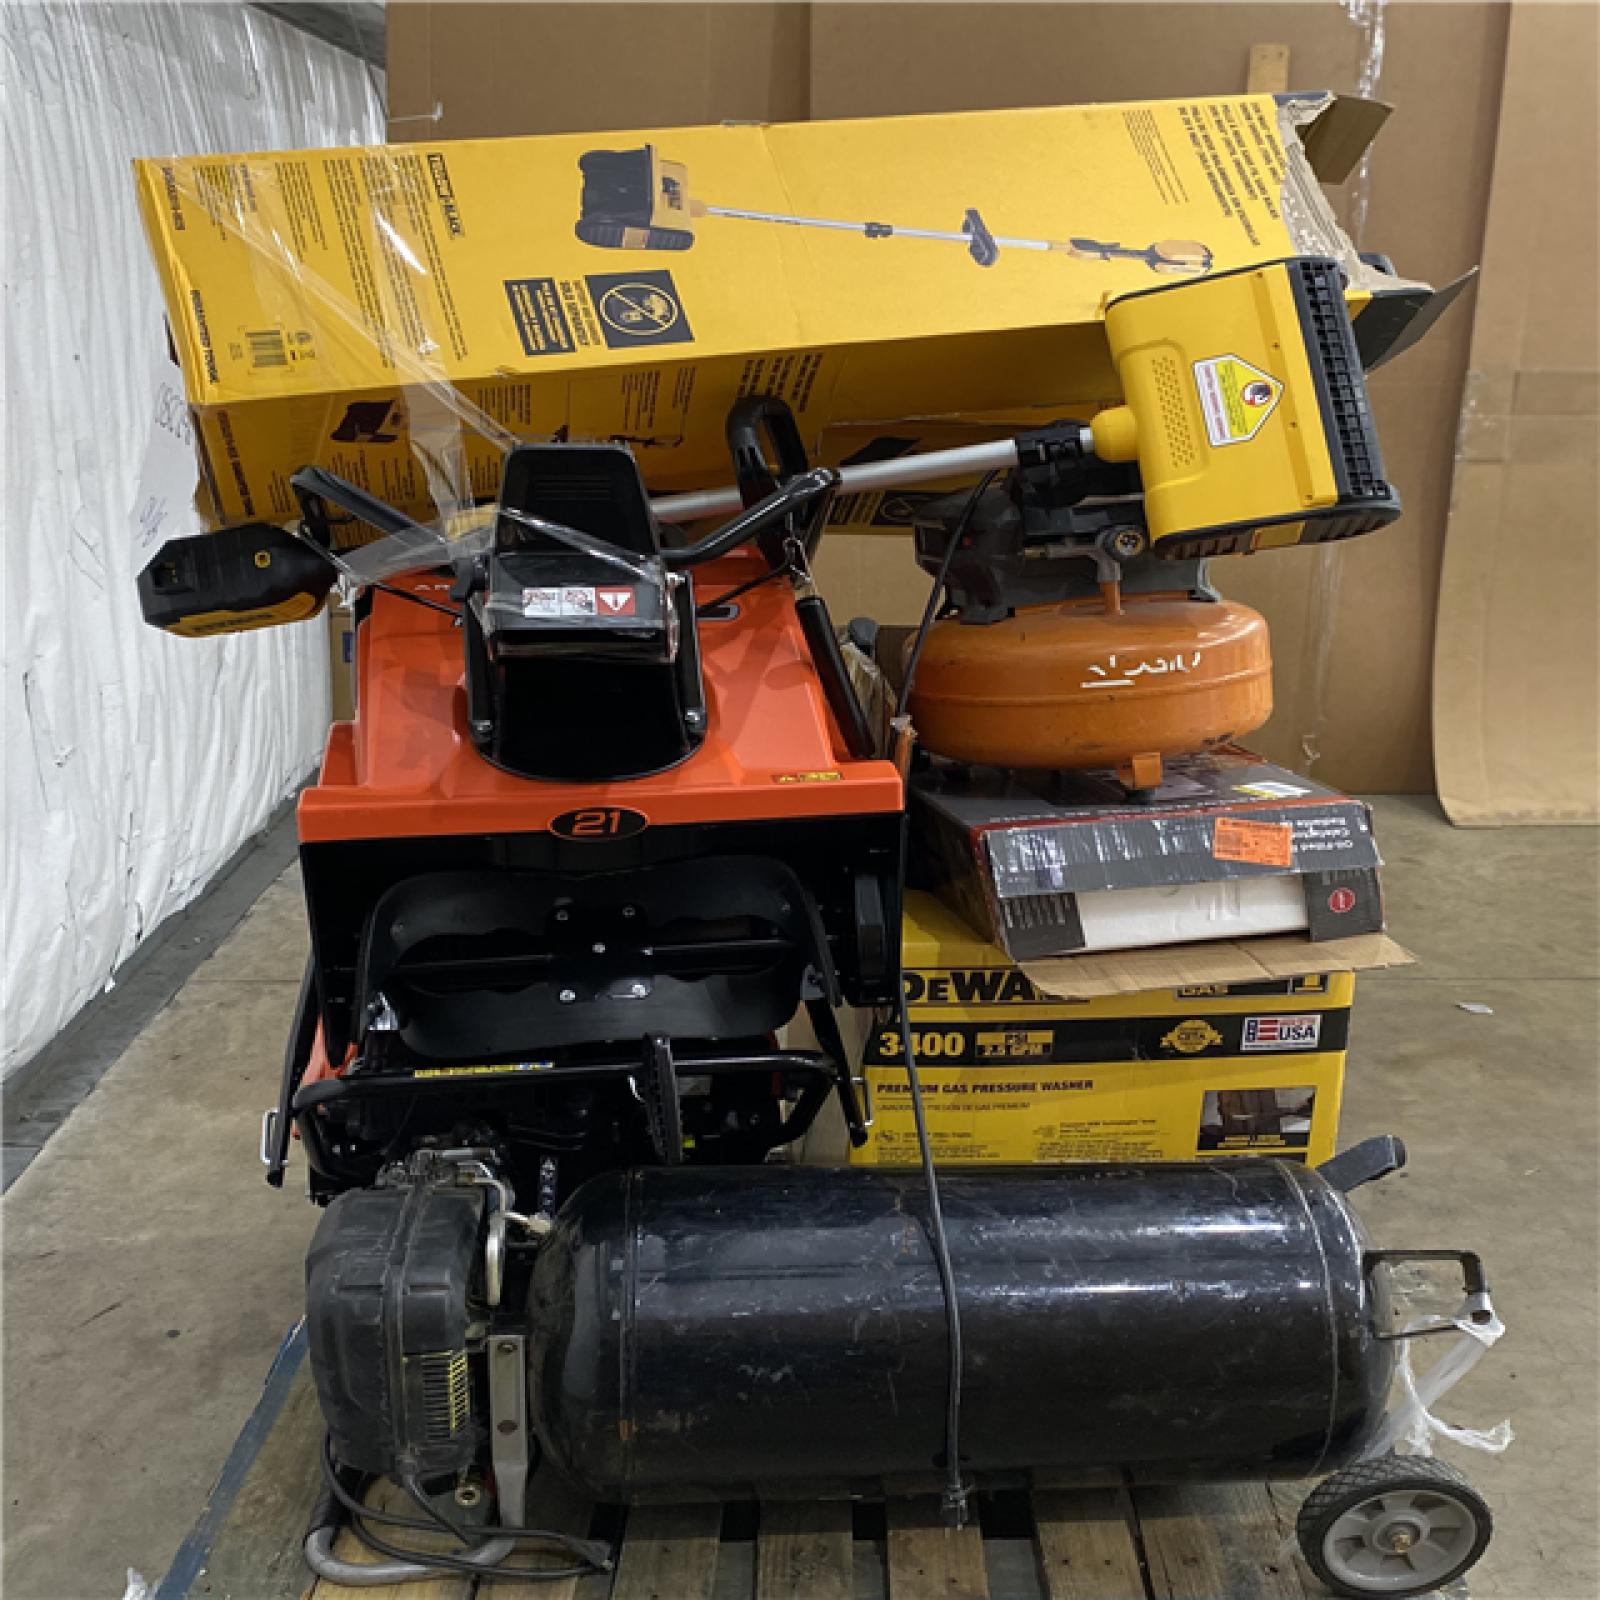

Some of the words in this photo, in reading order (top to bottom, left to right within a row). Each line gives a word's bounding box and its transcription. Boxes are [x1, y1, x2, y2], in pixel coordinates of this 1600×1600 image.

[573, 811, 620, 835] 21
[902, 971, 1088, 1000] DEWA
[1279, 1024, 1316, 1041] USA
[877, 1083, 938, 1094] PREMUM
[942, 1082, 968, 1094] GAS
[973, 1081, 1036, 1093] PRESSURE
[1040, 1079, 1094, 1091] WASHER
